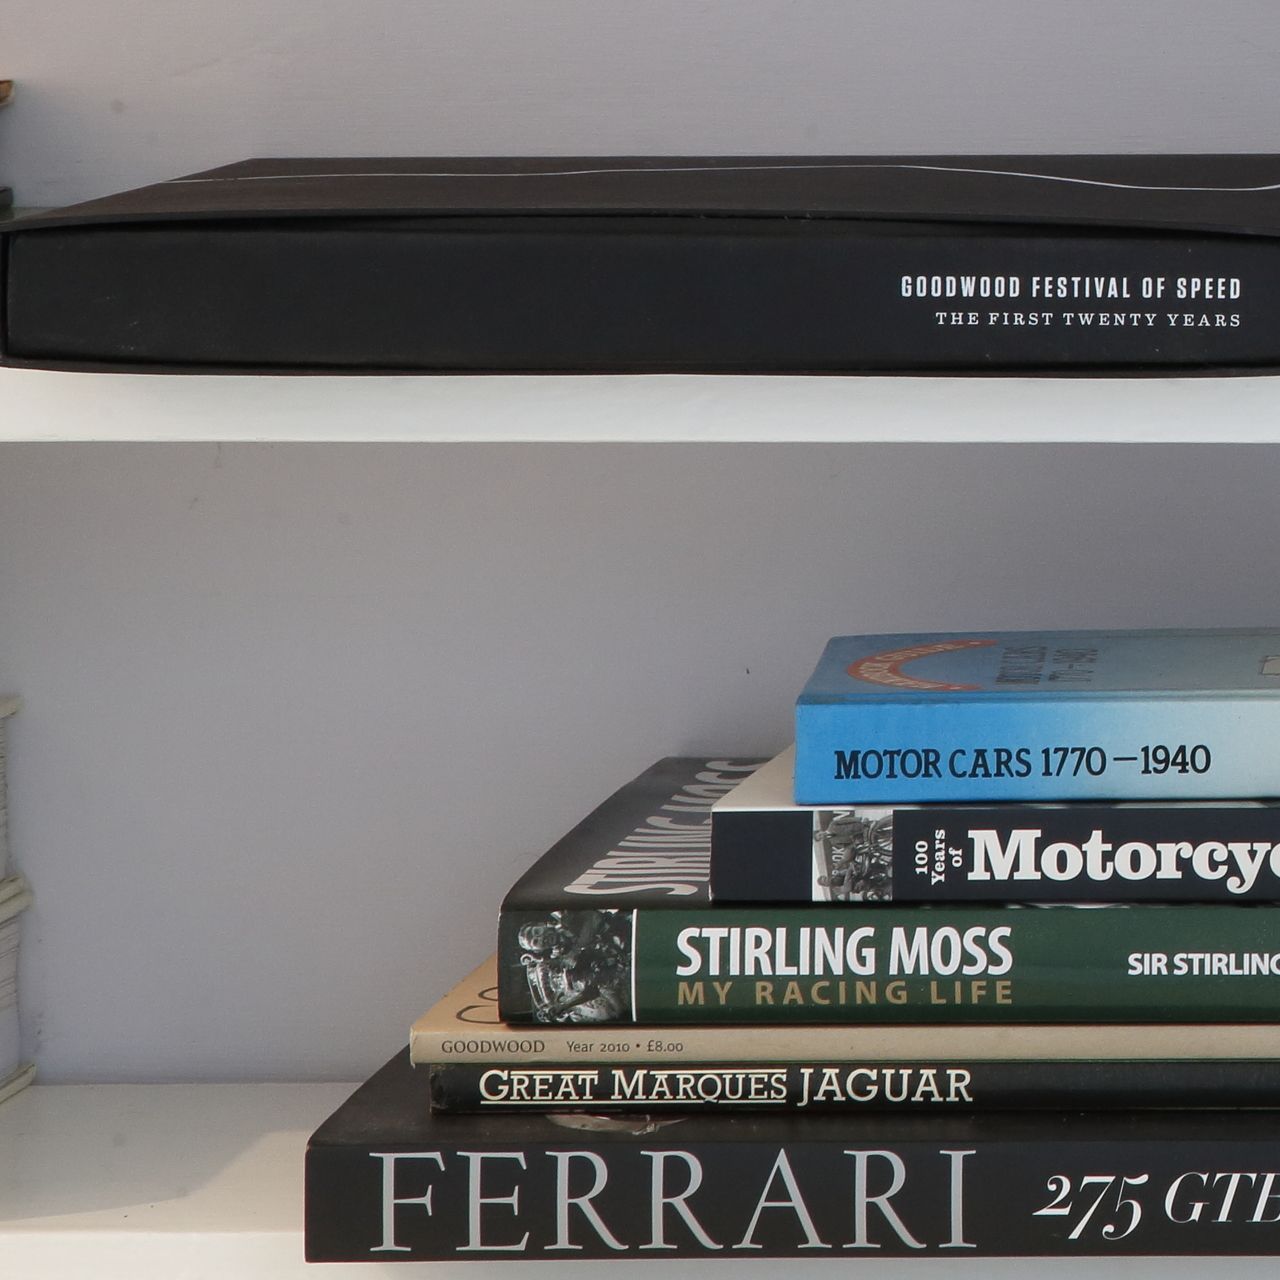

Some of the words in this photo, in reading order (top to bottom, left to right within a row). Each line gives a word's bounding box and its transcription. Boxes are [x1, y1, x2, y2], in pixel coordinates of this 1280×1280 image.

[900, 275, 1020, 299] GOODWOOD
[1031, 276, 1134, 299] FESTIVAL
[1142, 276, 1166, 299] OF
[1175, 277, 1241, 300] SPEED
[935, 311, 980, 326] THE
[988, 311, 1054, 326] FIRST
[1063, 312, 1158, 327] TWENTY
[1166, 312, 1241, 328] YEARS
[834, 748, 943, 781] MOTOR
[948, 748, 1033, 779] CARS
[914, 840, 929, 875] 100
[930, 828, 946, 886] Years
[948, 847, 963, 868] of
[675, 926, 877, 977] STIRLING
[888, 925, 1014, 977] MOSS
[1127, 953, 1169, 977] SIR
[677, 980, 734, 1006] MY
[754, 980, 908, 1006] RACING
[929, 980, 1013, 1006] LIFE
[440, 1038, 545, 1055] GOODWOOD
[566, 1039, 595, 1054] Year
[599, 1041, 631, 1054] 2010
[646, 1039, 684, 1054] £8.00
[478, 1067, 600, 1103] GREAT
[611, 1066, 788, 1104] MARQUES
[796, 1068, 974, 1107] JAGUAR
[367, 1147, 978, 1254] FERRARI
[1032, 1172, 1152, 1241] 275
